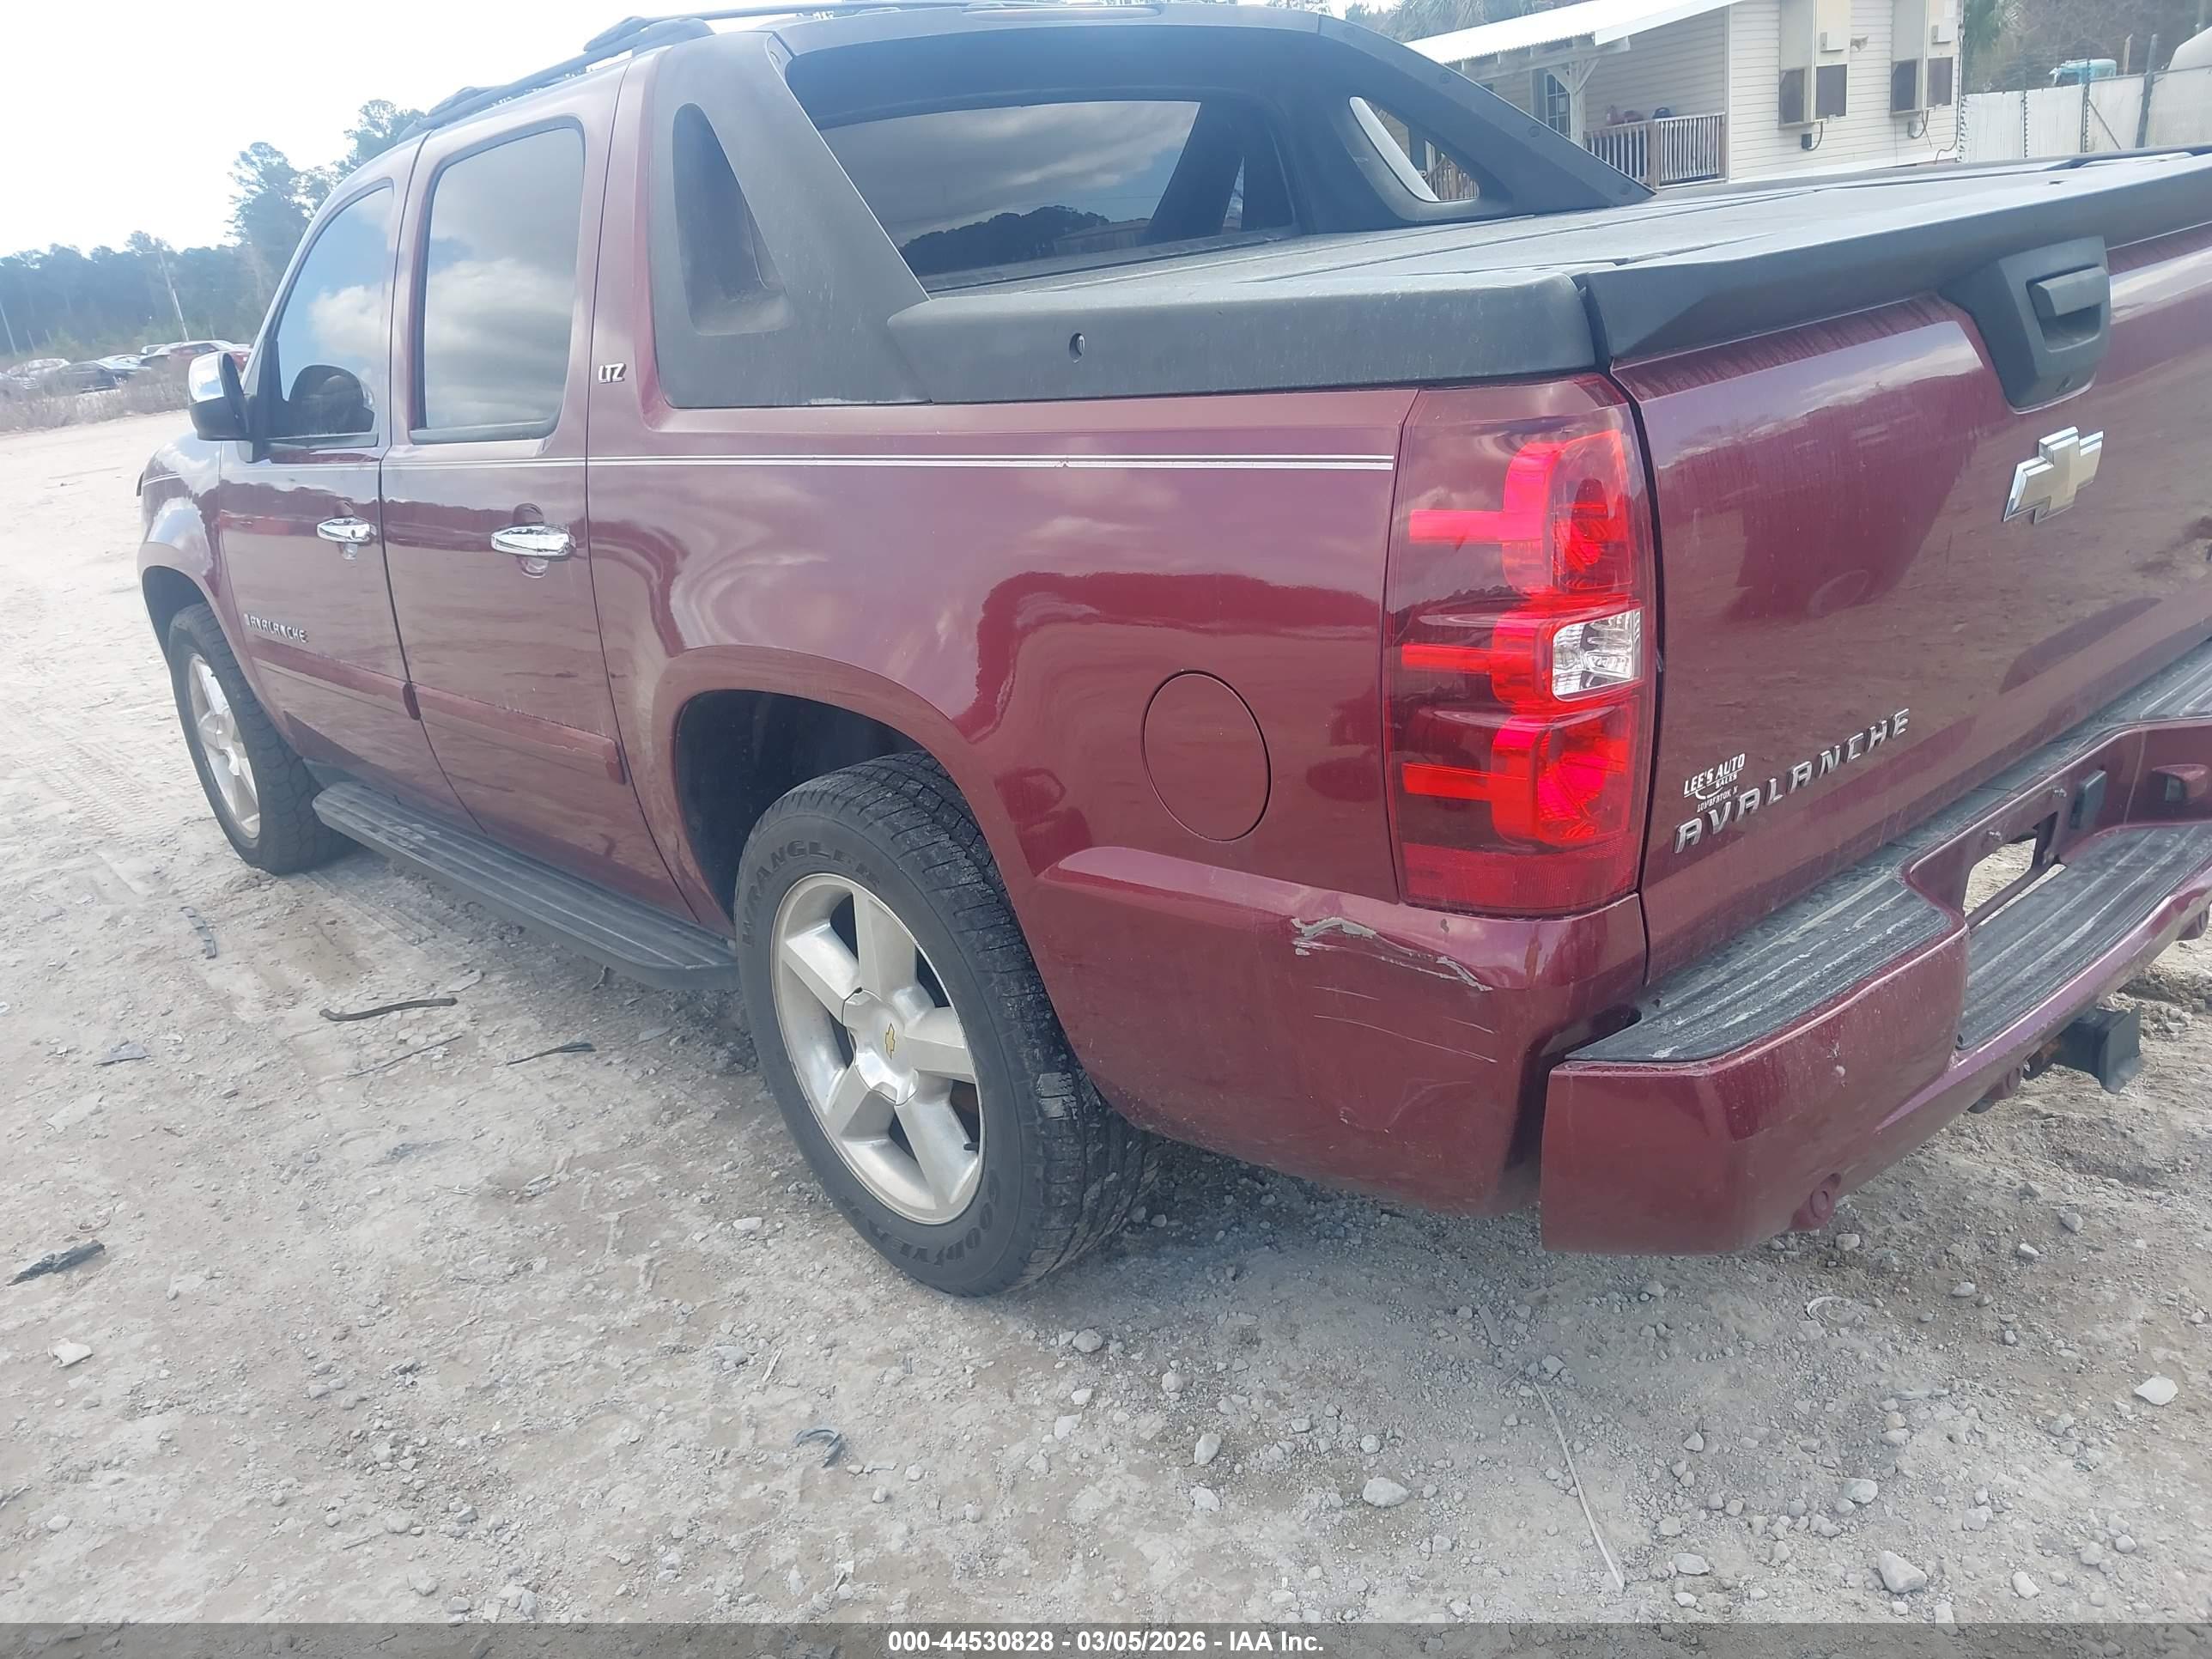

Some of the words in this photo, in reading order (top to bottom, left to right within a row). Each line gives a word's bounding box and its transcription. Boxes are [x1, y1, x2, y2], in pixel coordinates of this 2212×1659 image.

[599, 362, 626, 384] LTZ
[250, 615, 309, 643] AVALANCHE
[1674, 708, 1909, 854] AVALANCHE
[1684, 768, 1714, 795] LEE'S
[1716, 753, 1745, 779] AUTO
[1715, 773, 1737, 789] SALES
[742, 840, 880, 945] WRANGLER
